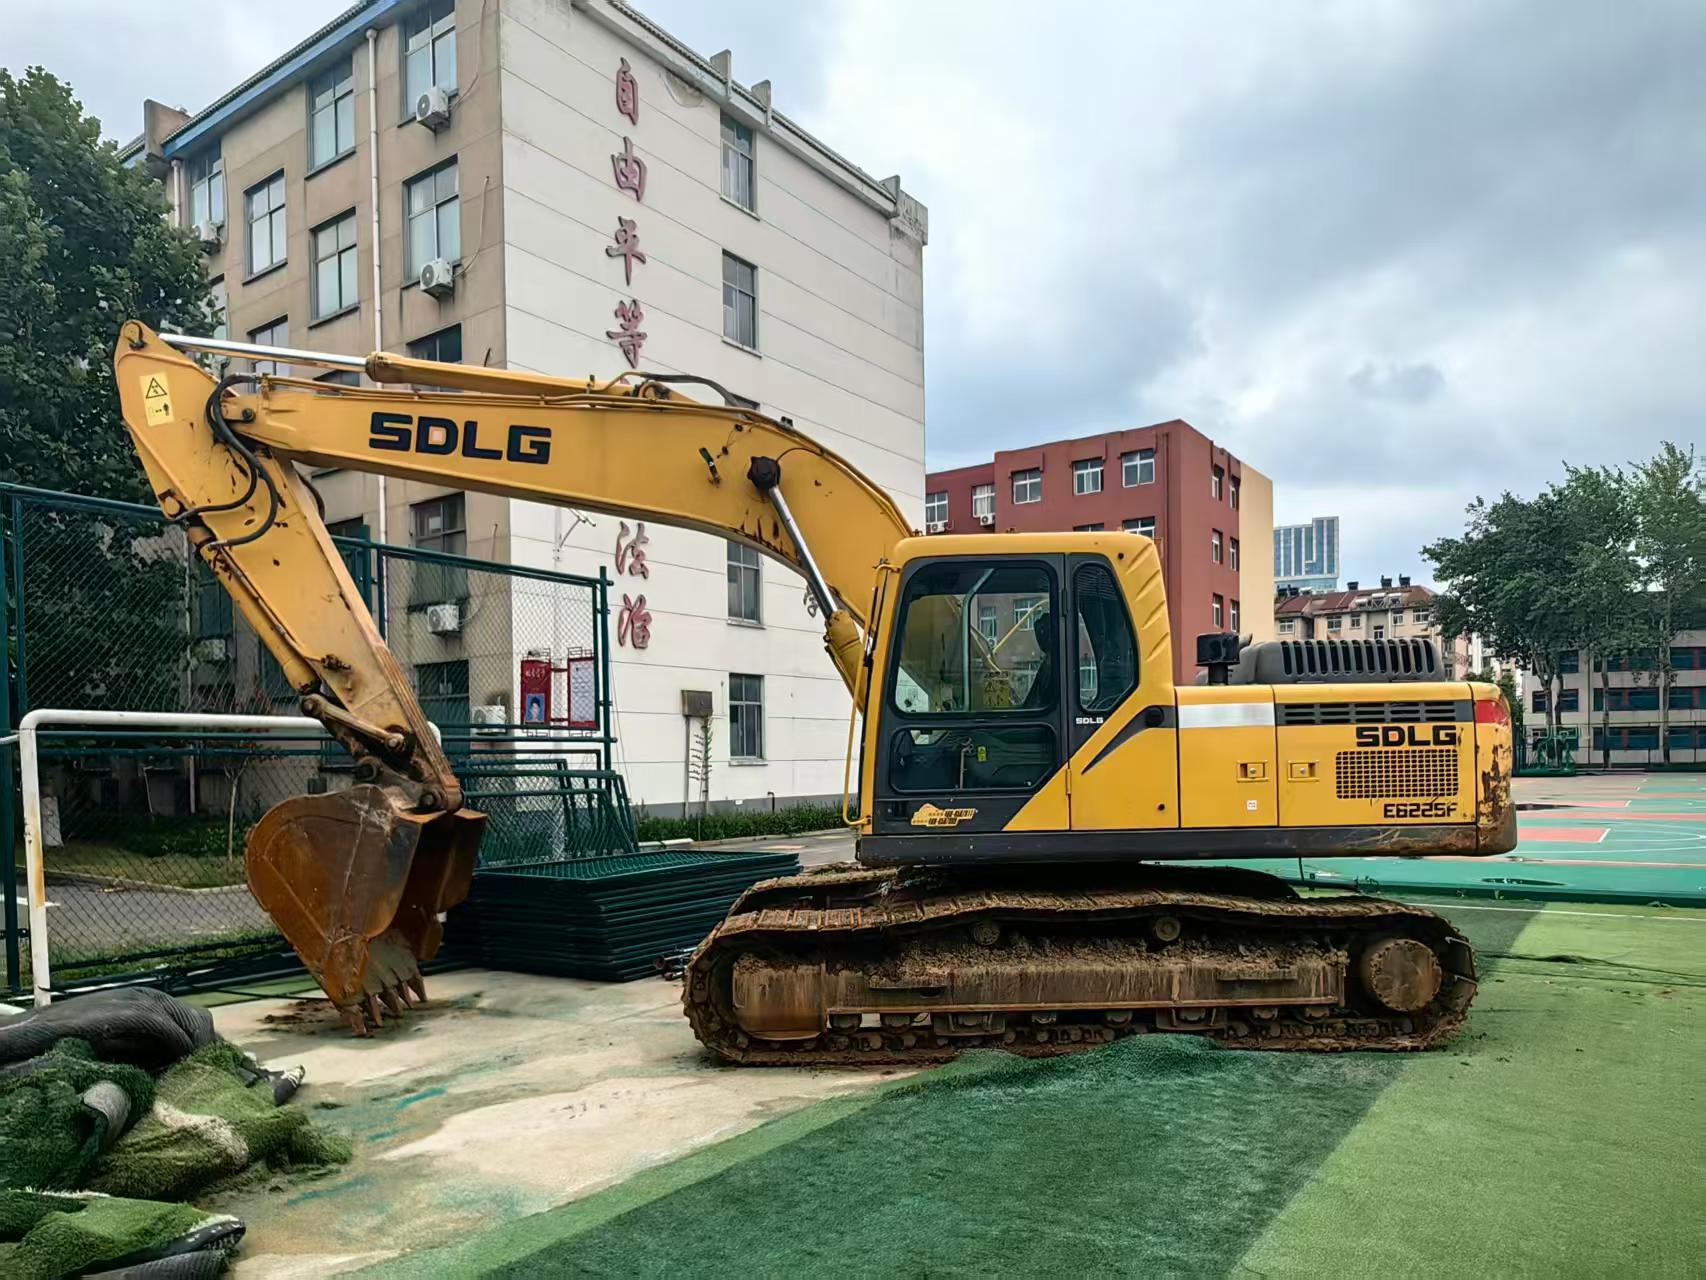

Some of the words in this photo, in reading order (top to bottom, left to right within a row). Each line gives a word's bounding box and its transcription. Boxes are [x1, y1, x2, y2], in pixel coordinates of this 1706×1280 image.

[605, 56, 647, 369] 自由平等
[369, 412, 552, 464] SDLG
[615, 520, 652, 649] 法治
[1075, 716, 1104, 725] SDLG
[1355, 725, 1457, 747] SDLG
[1384, 803, 1458, 818] E6225F
